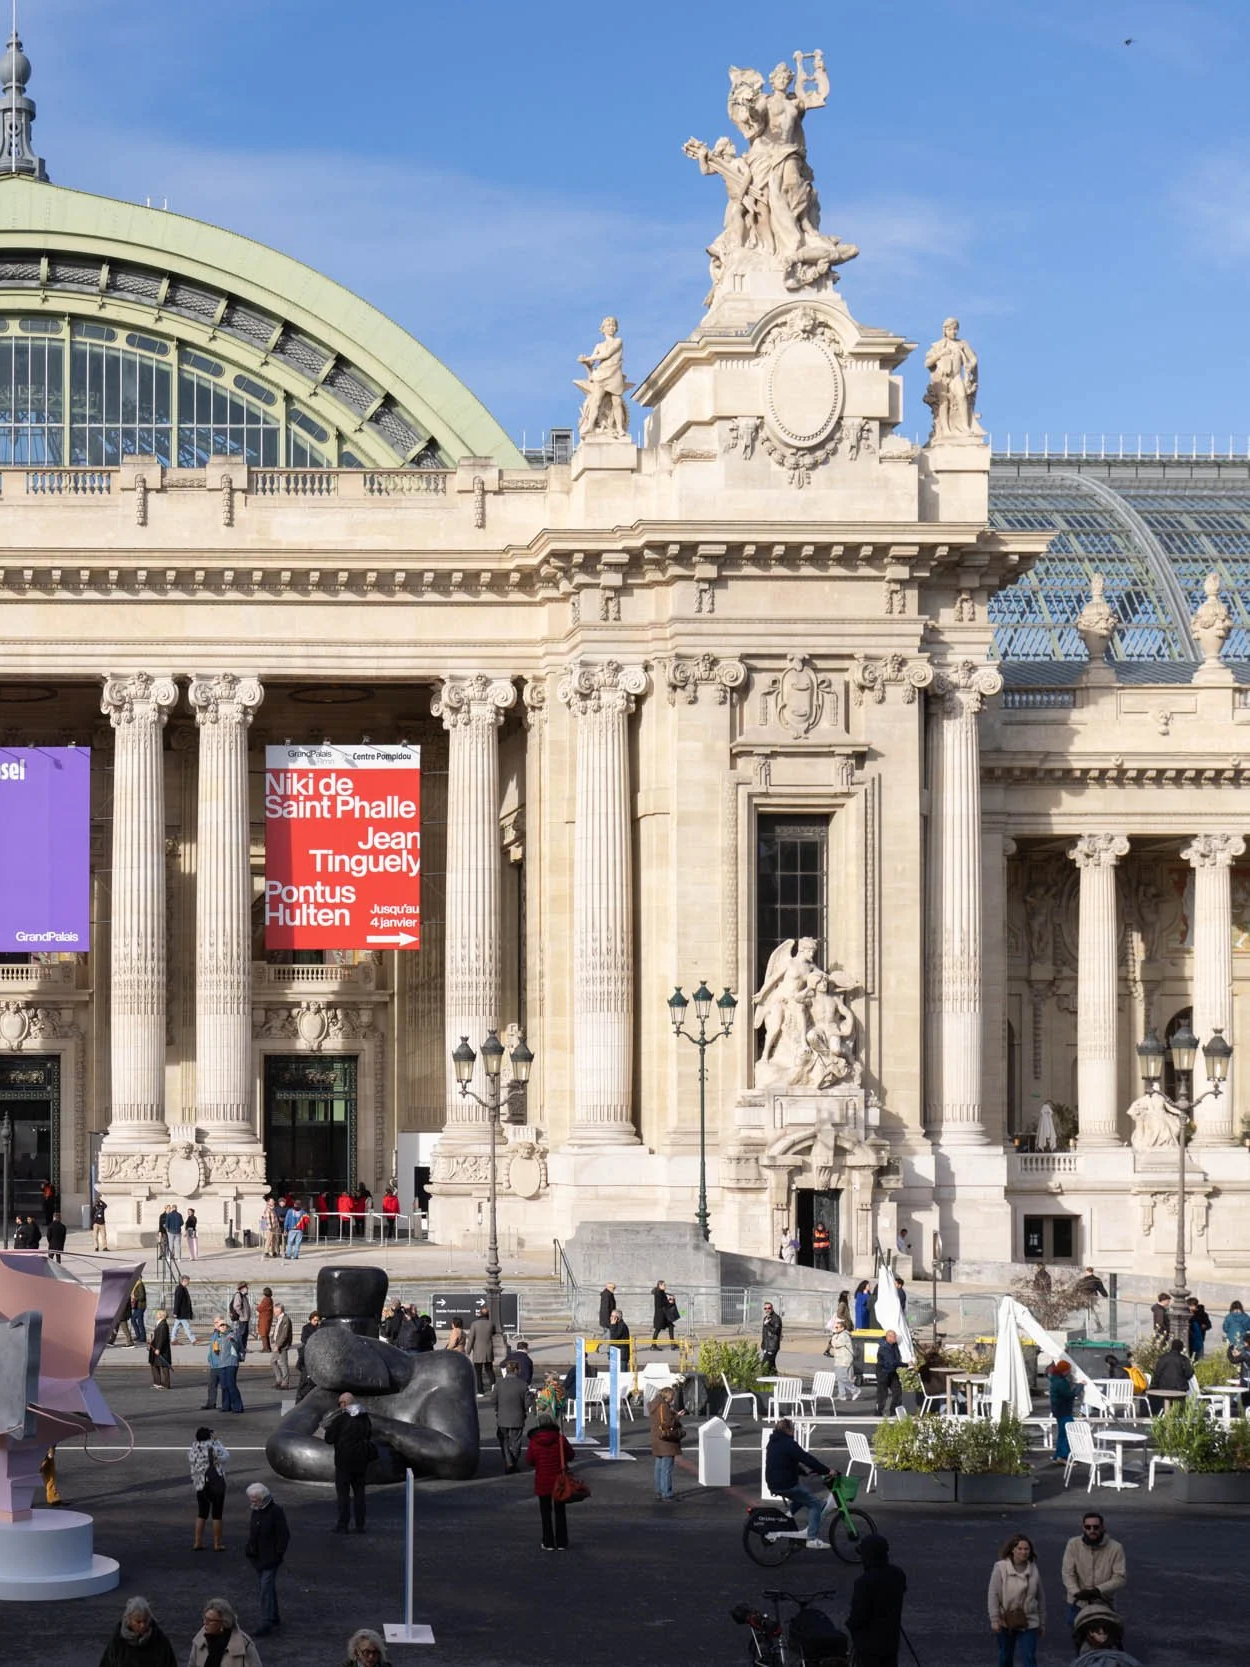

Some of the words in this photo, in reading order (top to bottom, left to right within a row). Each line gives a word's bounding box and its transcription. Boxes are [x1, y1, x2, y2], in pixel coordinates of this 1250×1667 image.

[352, 752, 376, 761] Centre
[376, 752, 412, 763] Pompidou
[265, 772, 314, 796] Niki
[318, 772, 354, 796] de
[265, 795, 332, 818] Saint
[336, 796, 417, 818] Phalle
[358, 826, 420, 850] Jean
[308, 849, 420, 877] Tinguely
[265, 880, 357, 903] Pontus
[265, 903, 351, 926] Hulten
[369, 916, 380, 928] 4
[379, 916, 418, 930] janvier
[15, 931, 79, 942] GrandPalais
